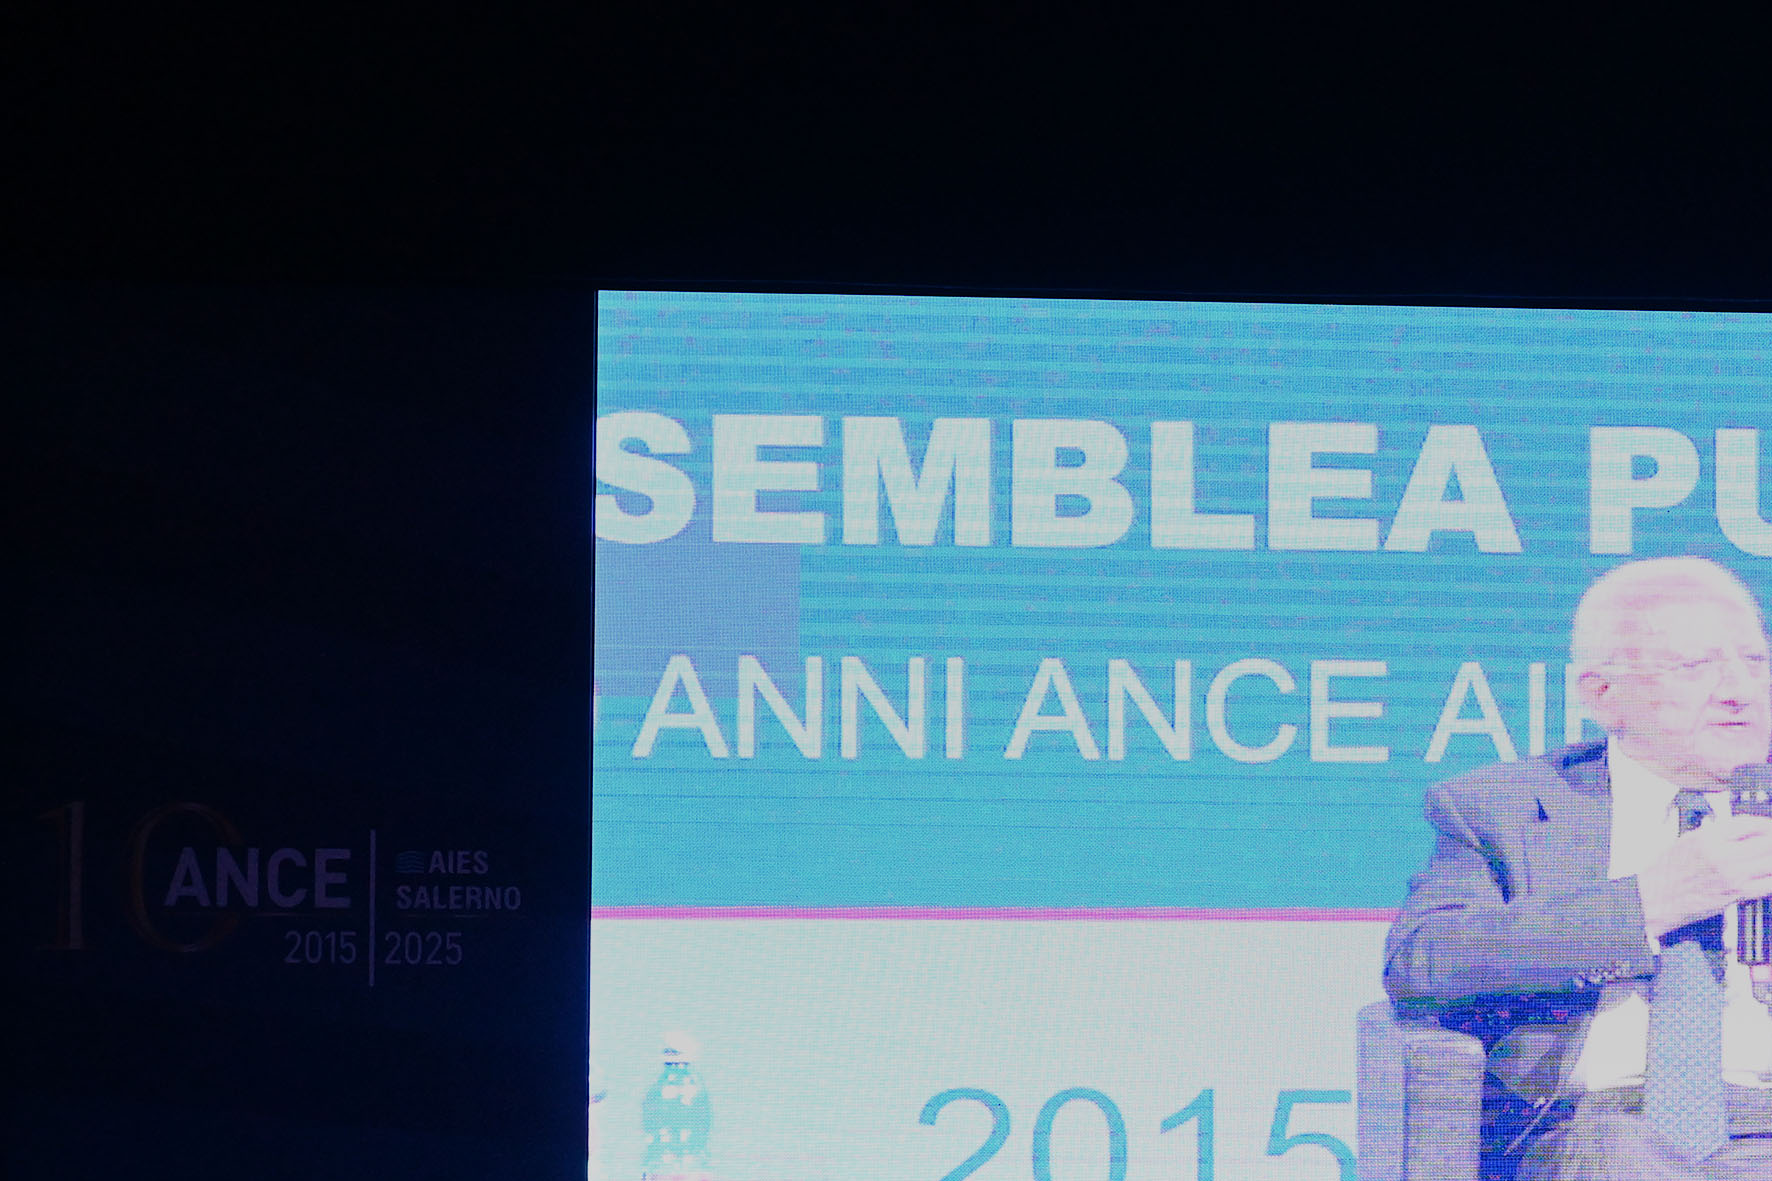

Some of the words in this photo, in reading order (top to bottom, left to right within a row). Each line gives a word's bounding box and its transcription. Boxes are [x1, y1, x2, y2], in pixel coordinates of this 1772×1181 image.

[595, 411, 1523, 556] SEMBLEA
[631, 654, 965, 760] ANNI
[1002, 658, 1391, 764] ANCE
[164, 846, 352, 909] ANCE
[428, 849, 490, 875] AIES
[395, 884, 522, 910] SALERNO
[284, 930, 358, 966] 2015
[384, 930, 464, 967] 2025
